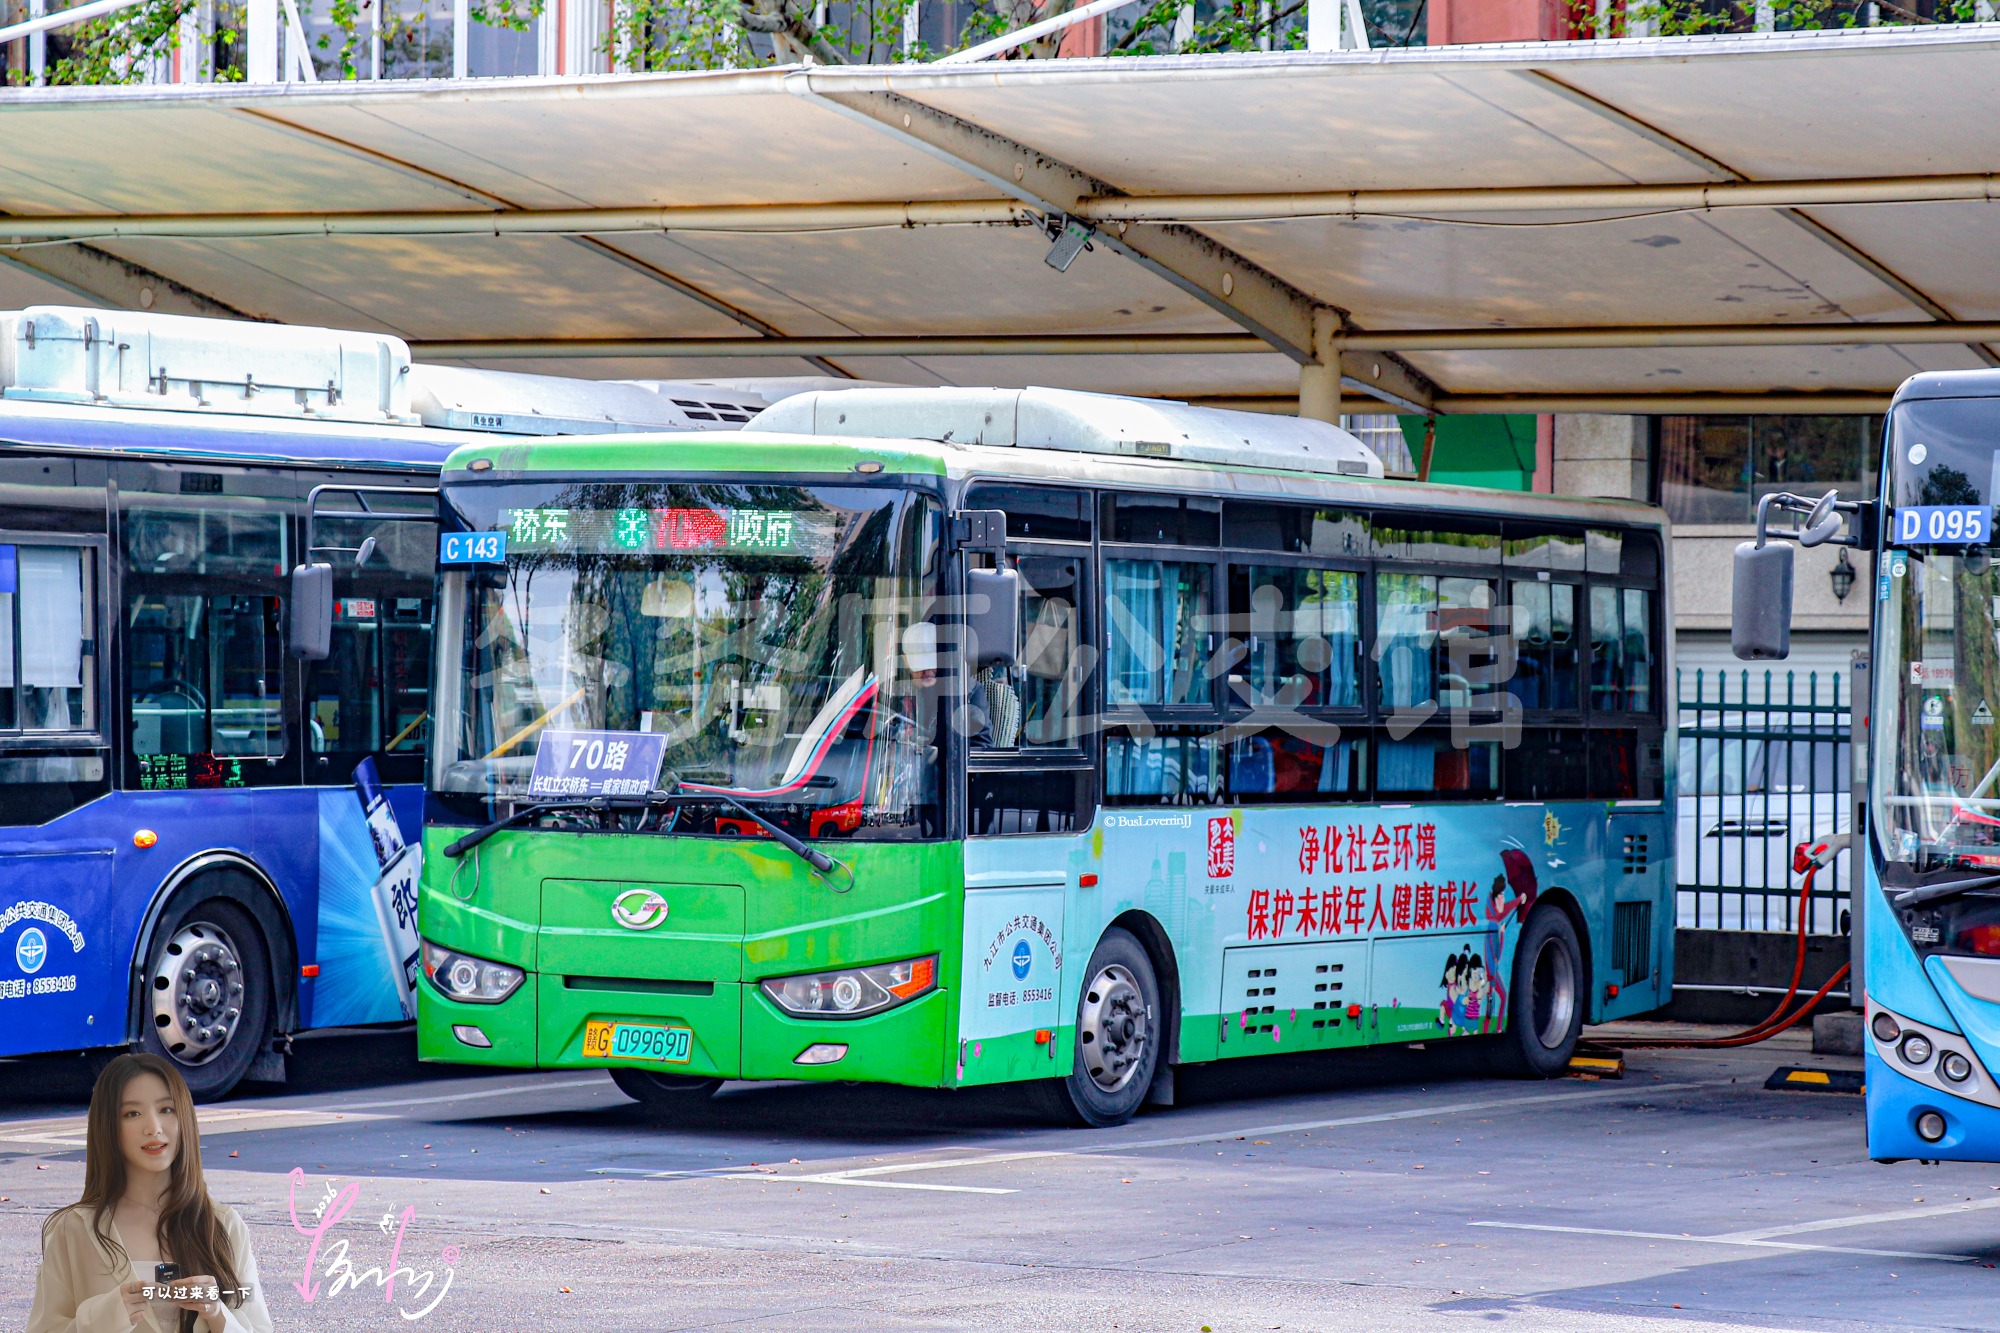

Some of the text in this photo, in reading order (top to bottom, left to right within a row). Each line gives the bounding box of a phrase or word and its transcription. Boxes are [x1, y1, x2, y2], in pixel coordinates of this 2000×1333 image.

[507, 508, 569, 542] 桥东
[731, 509, 792, 547] 政府
[1902, 510, 1982, 540] D 095
[446, 537, 498, 560] C 143
[569, 739, 629, 771] 70路
[1299, 822, 1437, 875] 净化社会环境
[1204, 884, 1235, 896] 关爱未成年人
[1246, 880, 1479, 941] 保护未成年人健康成长
[983, 914, 1063, 972] 九江市公共交通集团公司
